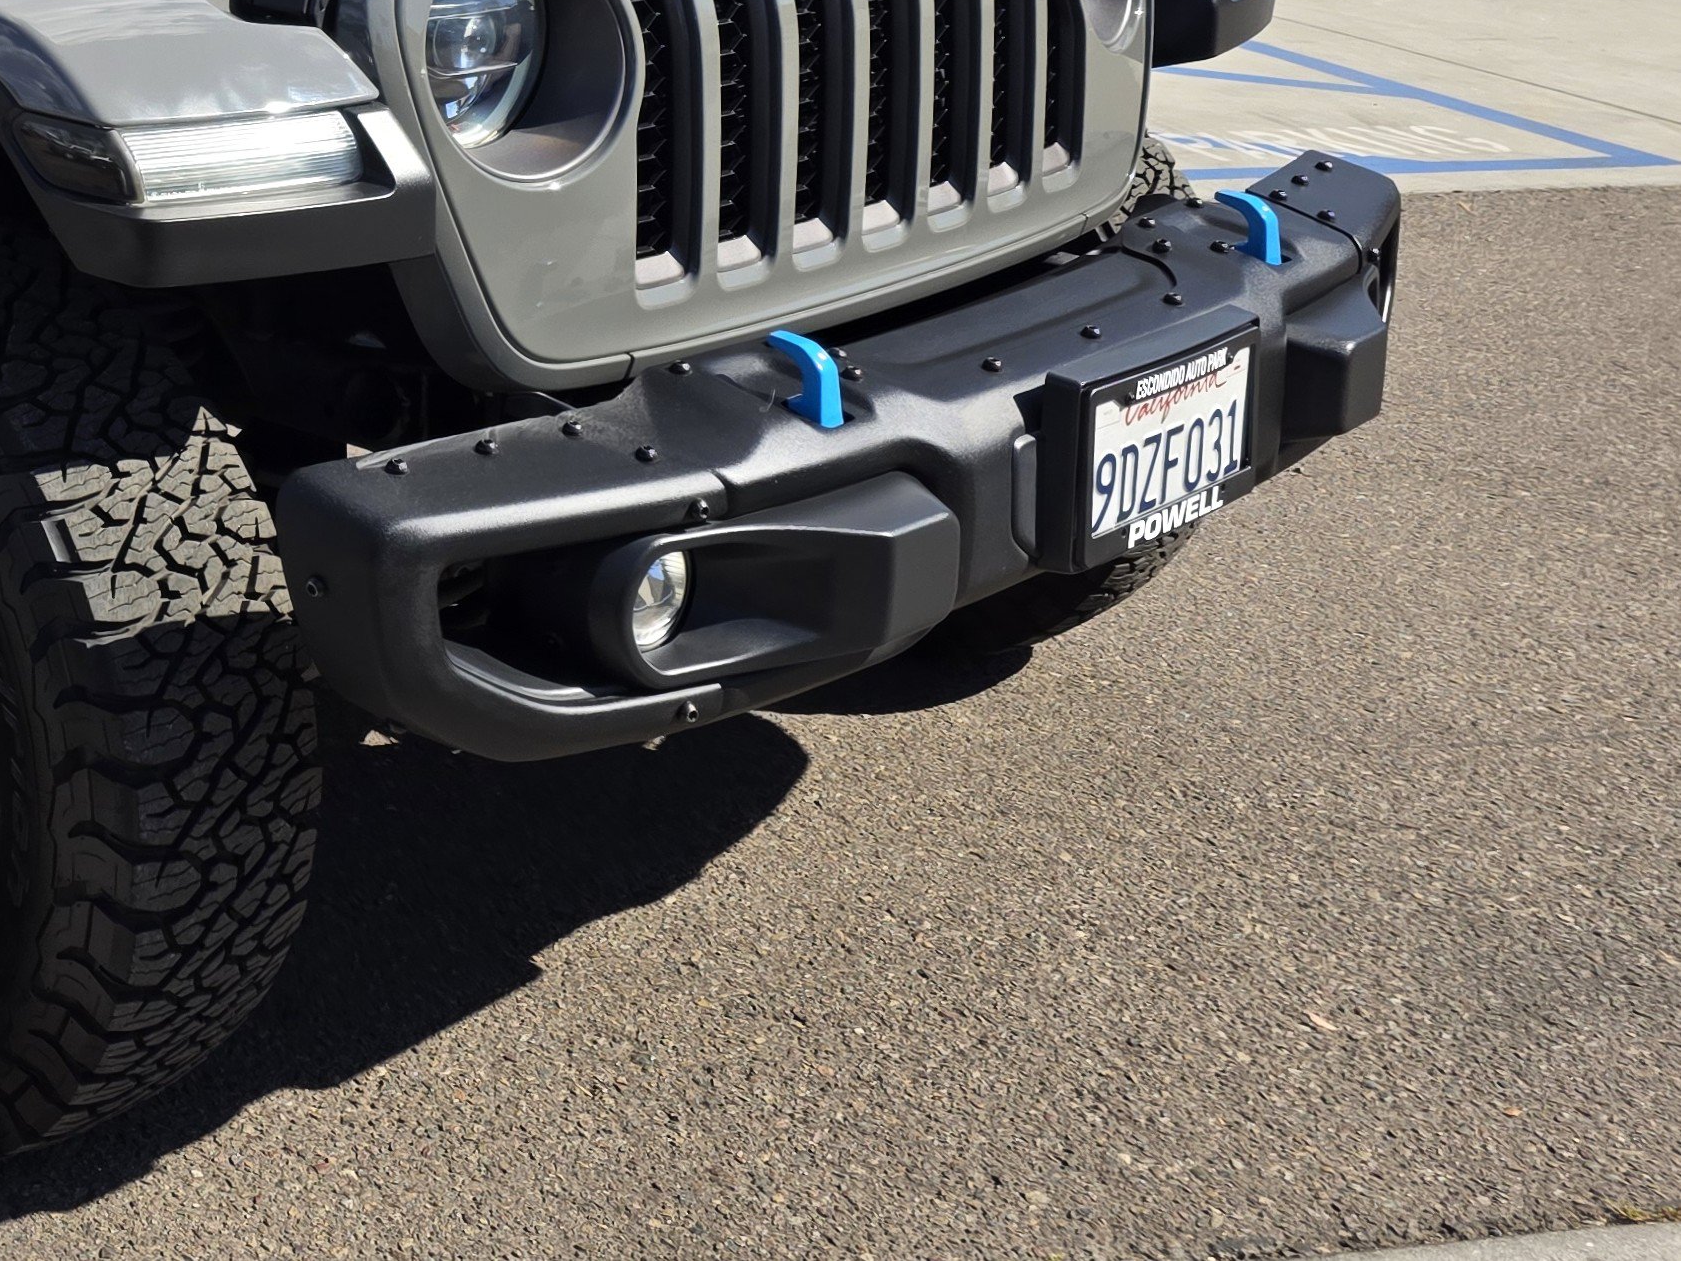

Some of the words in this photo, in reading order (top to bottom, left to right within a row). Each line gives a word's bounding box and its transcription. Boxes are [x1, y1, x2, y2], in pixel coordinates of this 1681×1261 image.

[1136, 365, 1186, 400] ESCONDIDO
[1185, 356, 1207, 382] AUTO
[1207, 347, 1228, 373] PARK
[1092, 398, 1238, 533] 9DZF031
[1128, 485, 1224, 549] POWELL
